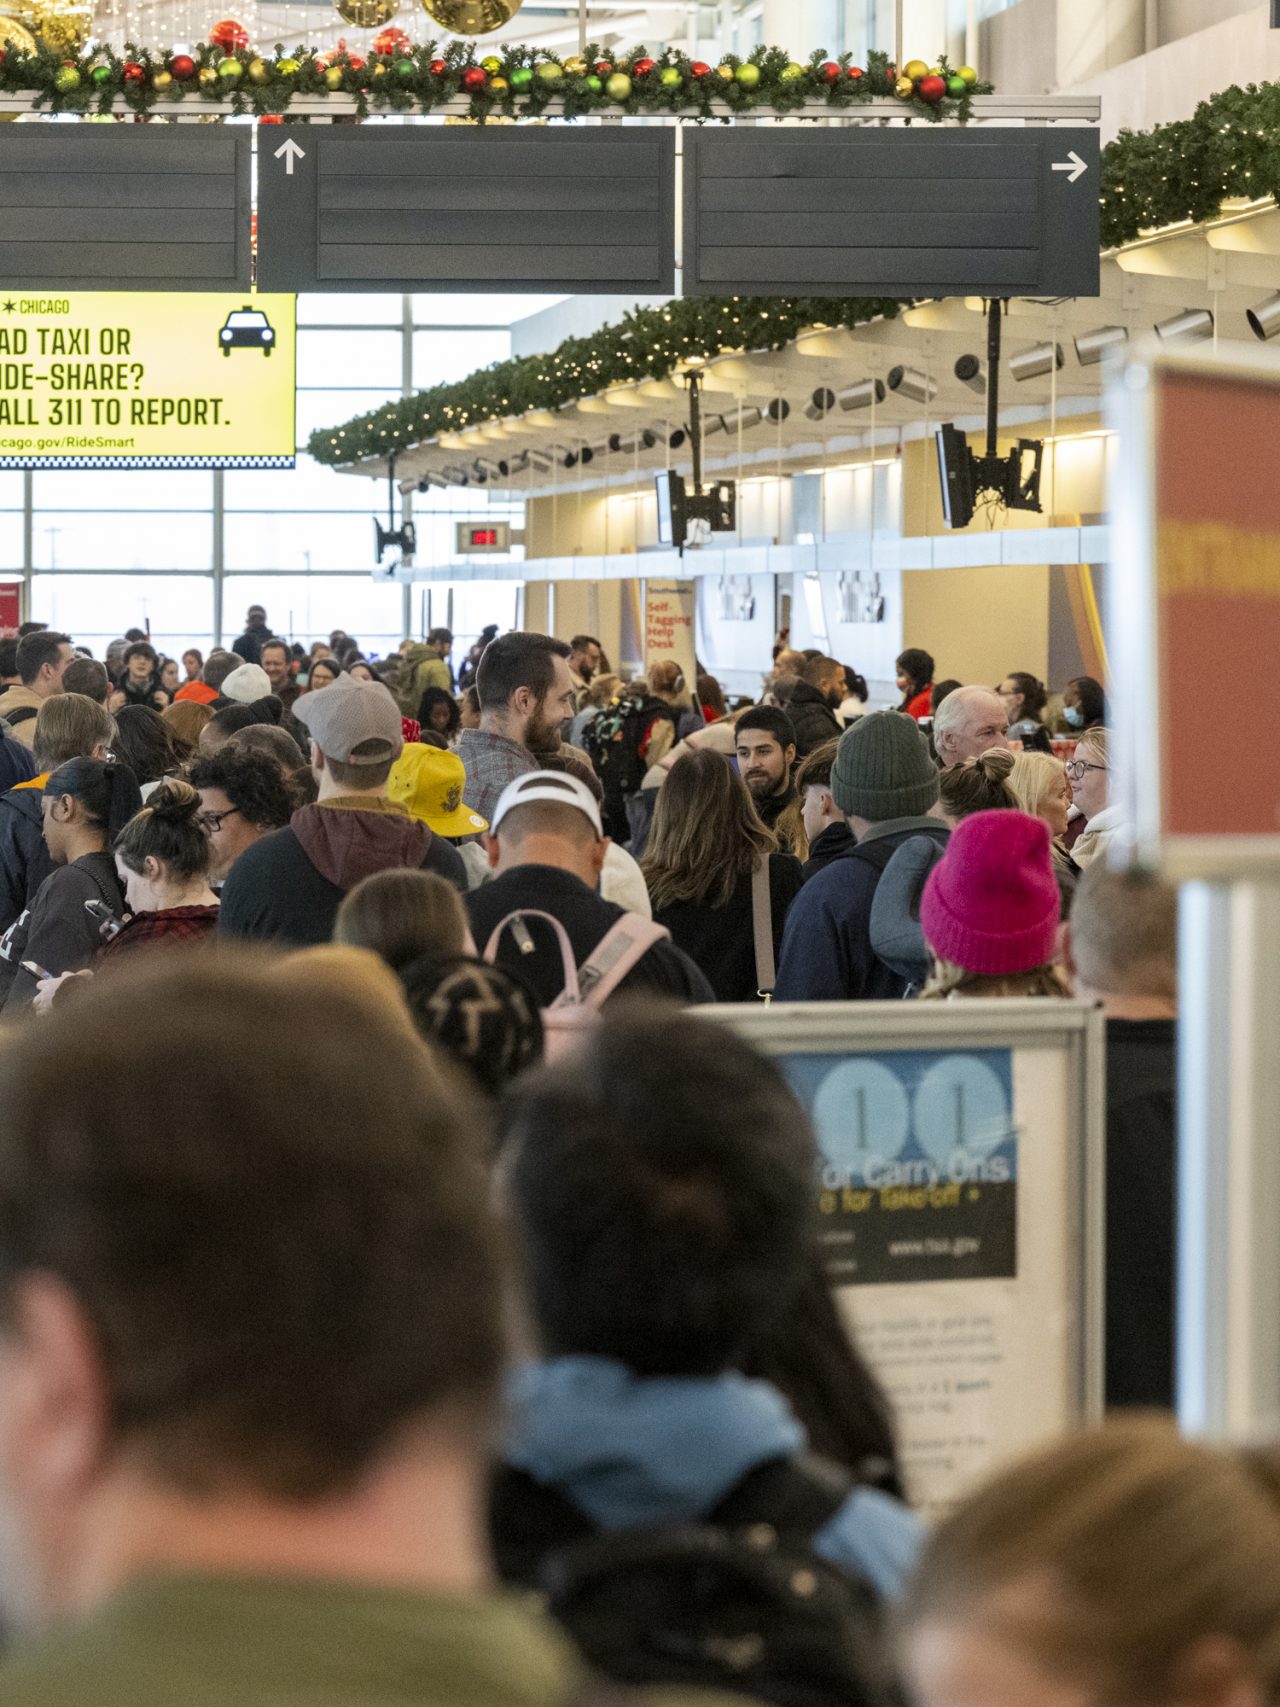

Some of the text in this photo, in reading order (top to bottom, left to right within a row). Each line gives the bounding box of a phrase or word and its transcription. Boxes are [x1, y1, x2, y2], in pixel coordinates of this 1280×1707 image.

[19, 299, 70, 314] CHICAGO
[36, 328, 90, 356] TAXI
[99, 328, 131, 356] OR
[48, 398, 83, 426] 311
[91, 398, 121, 426] TO
[130, 398, 231, 426] REPORT.
